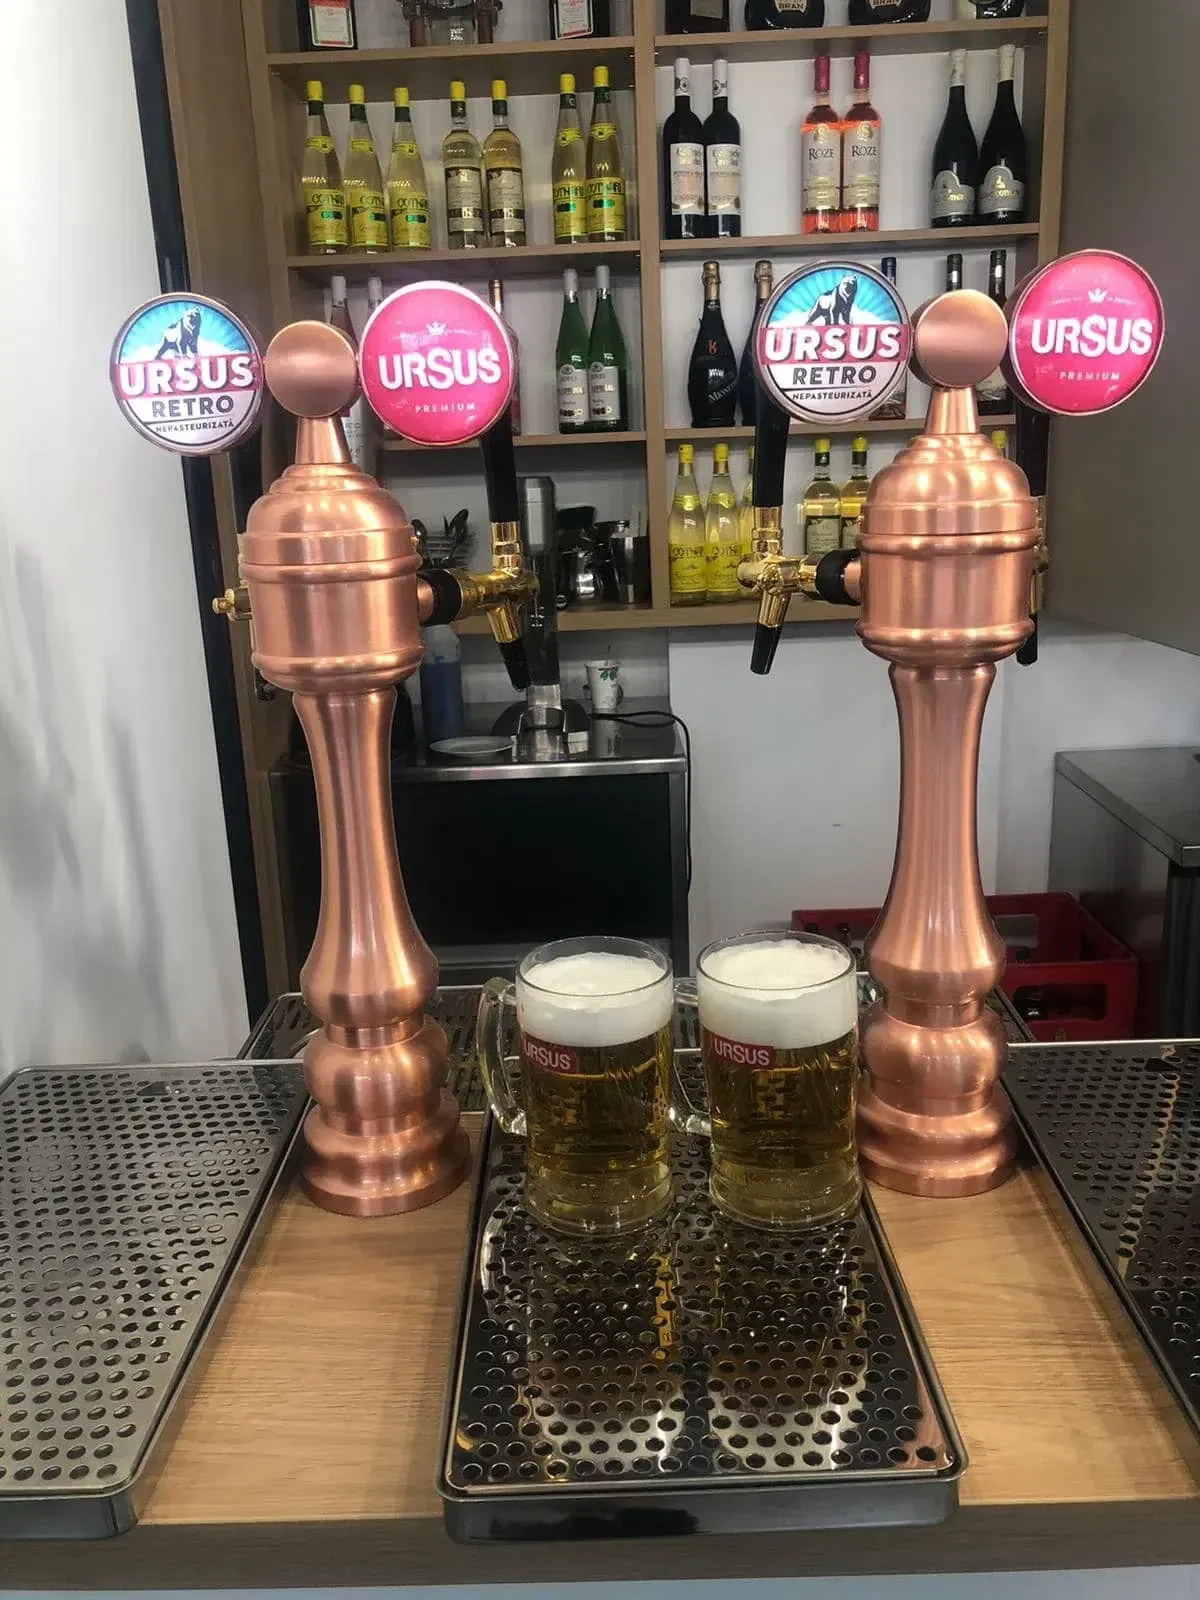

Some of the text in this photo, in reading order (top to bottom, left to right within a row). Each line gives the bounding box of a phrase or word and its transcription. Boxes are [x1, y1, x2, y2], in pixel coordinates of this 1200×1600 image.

[808, 148, 835, 160] ROZE
[850, 145, 878, 157] ROZE
[765, 326, 902, 362] URSUS
[1031, 314, 1153, 357] URSUS
[119, 355, 254, 397] URSUS
[378, 347, 502, 390] URSUS
[792, 365, 877, 385] RETRO
[1059, 371, 1121, 381] PREMIUM
[792, 389, 873, 401] NEPASTEURIZATĂ
[151, 395, 235, 418] RETRO
[415, 402, 476, 413] PREMIUM
[155, 418, 235, 433] NEPASTEURIZATĂ
[524, 1038, 572, 1071] URSUS
[714, 1037, 771, 1067] URSUS
